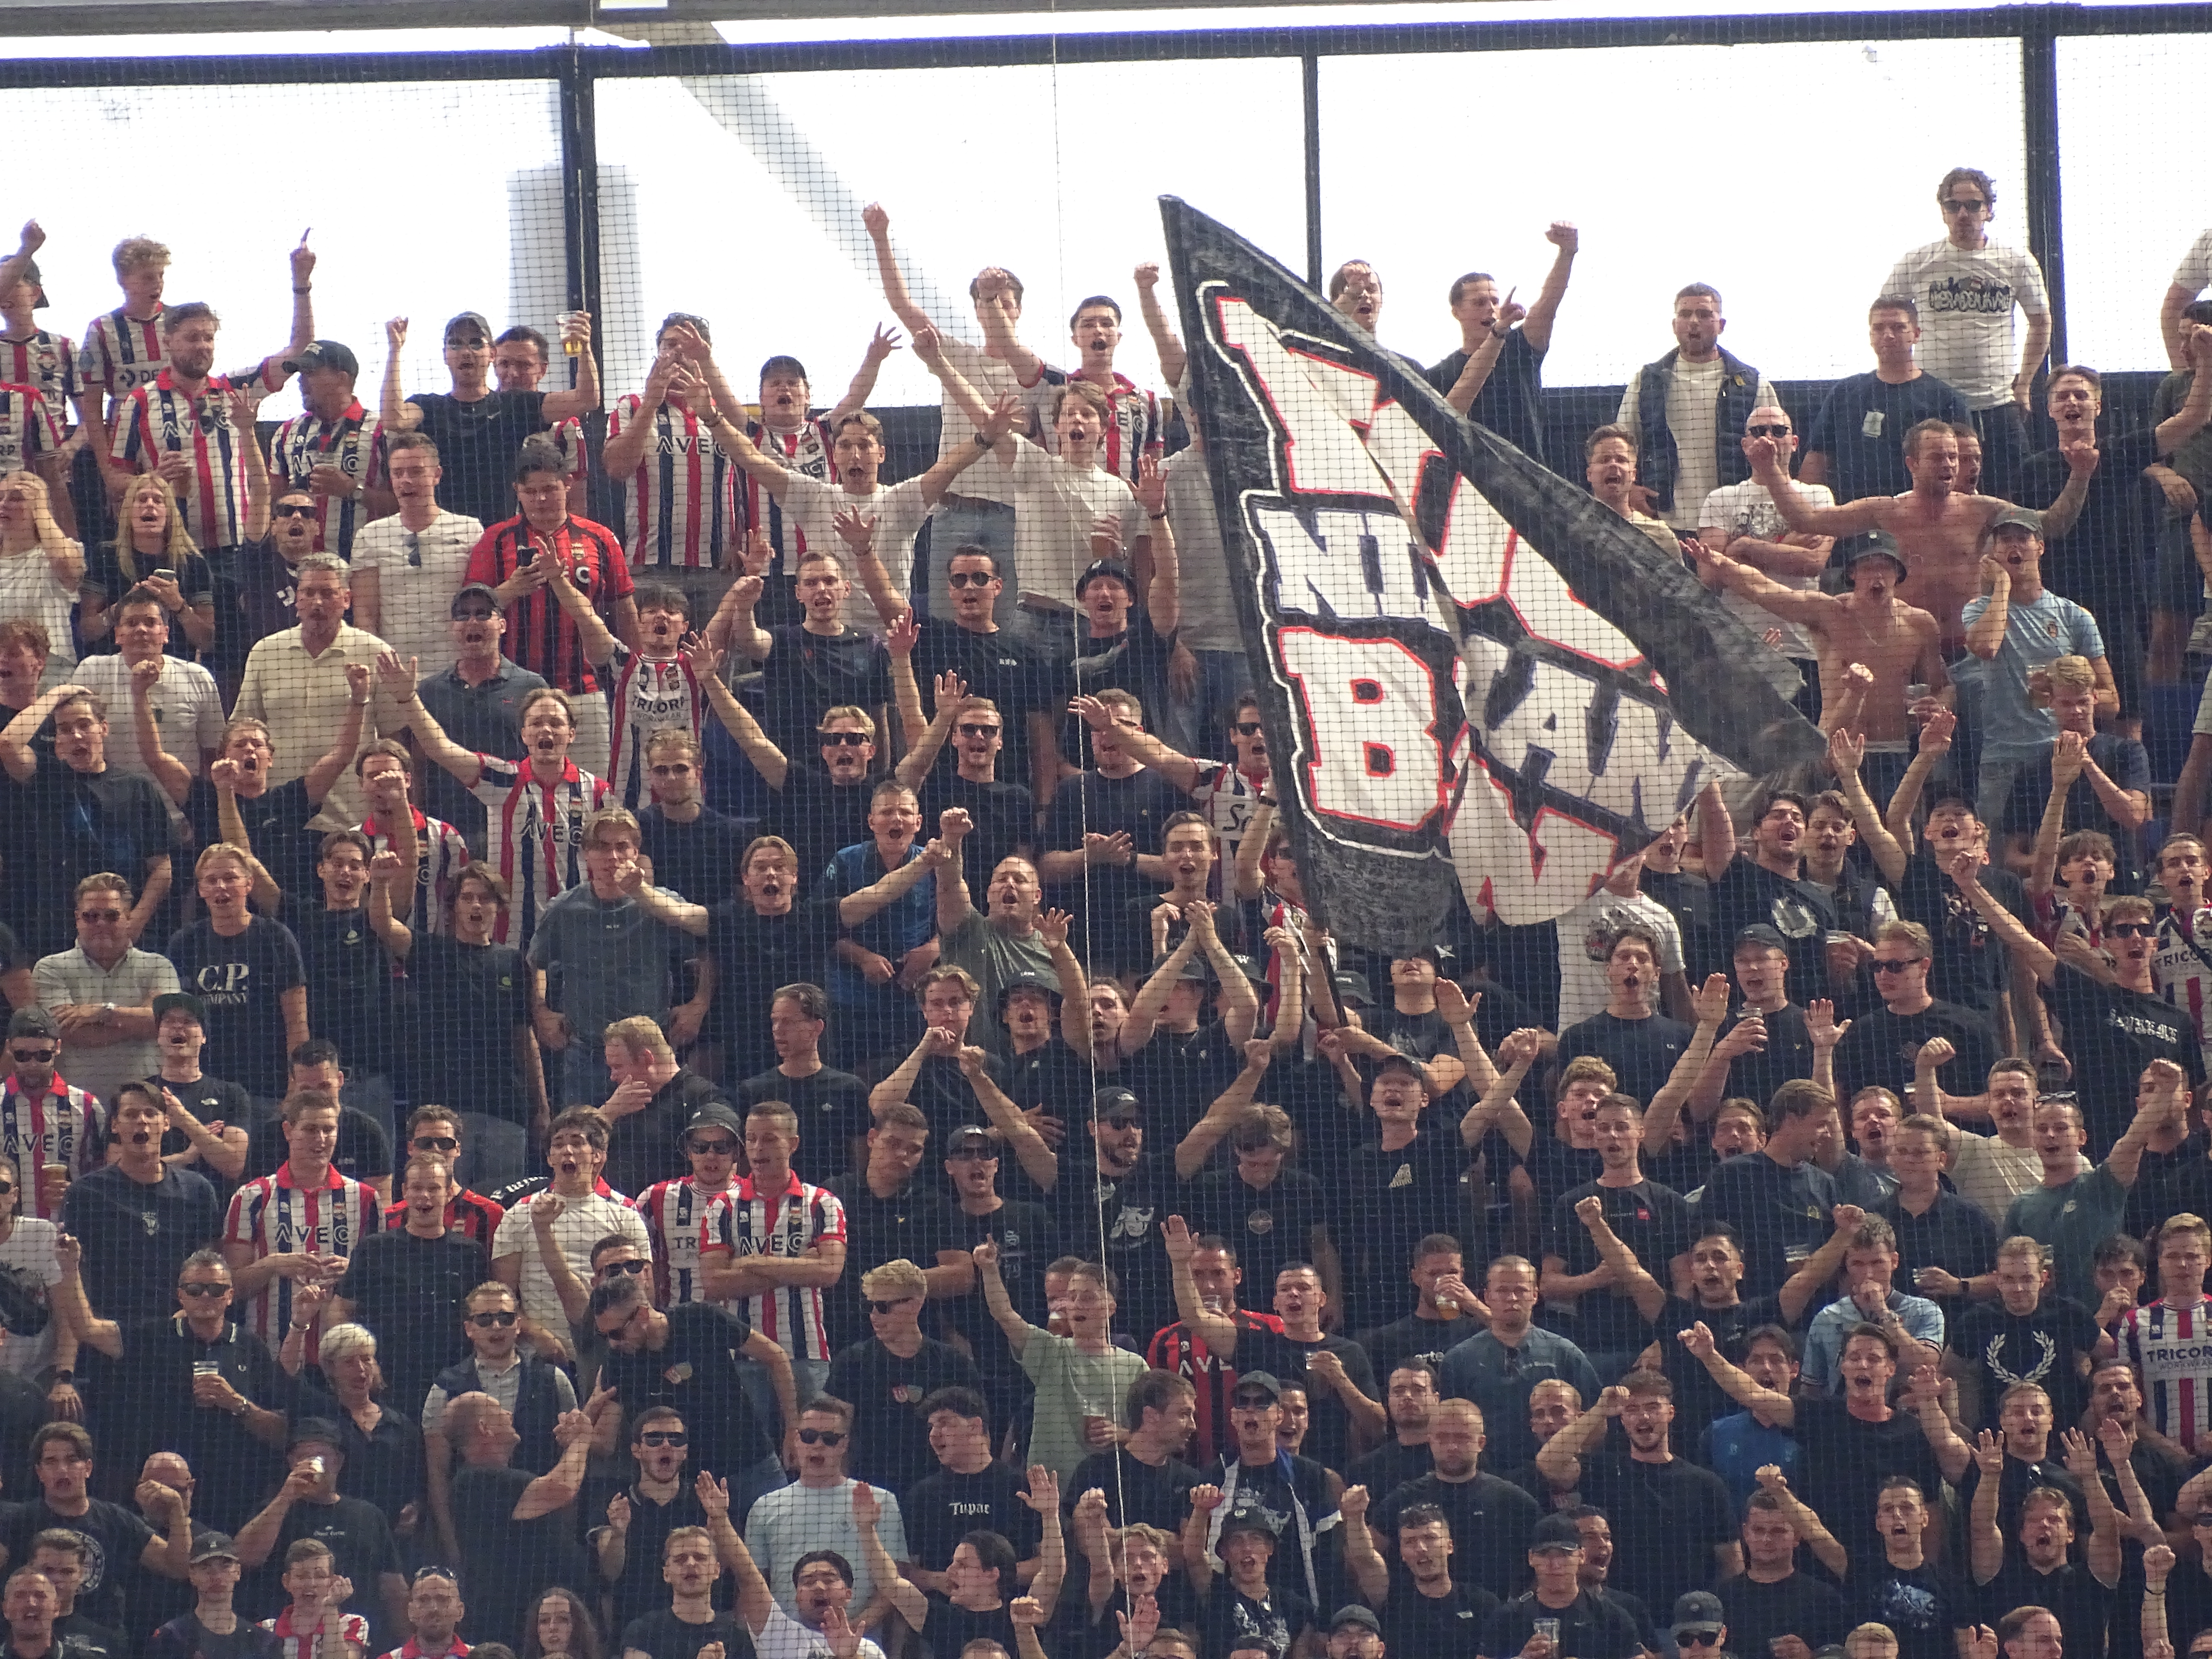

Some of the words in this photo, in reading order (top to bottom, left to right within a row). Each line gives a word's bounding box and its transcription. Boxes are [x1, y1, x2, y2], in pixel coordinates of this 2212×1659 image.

[2154, 950, 2200, 967] TRICO
[3, 1135, 74, 1158] AVEC
[275, 1225, 350, 1246] AVEC
[741, 1232, 804, 1257] AVEC
